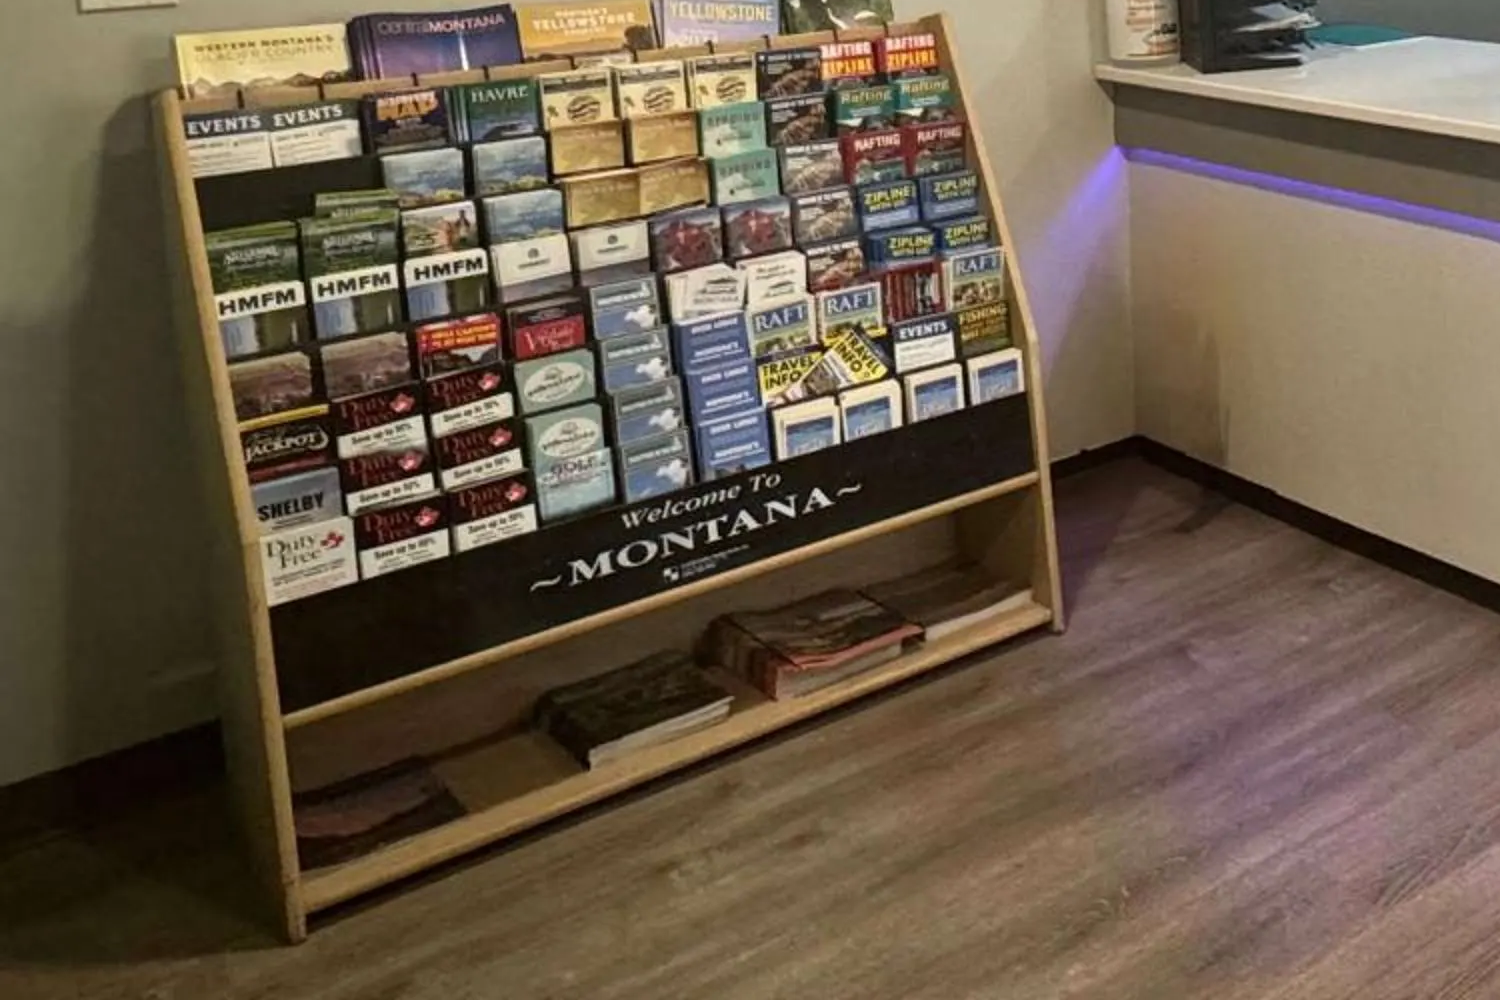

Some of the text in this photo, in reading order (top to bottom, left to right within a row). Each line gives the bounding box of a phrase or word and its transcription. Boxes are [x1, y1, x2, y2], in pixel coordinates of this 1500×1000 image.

[532, 11, 636, 32] YELLOWSTONE
[669, 1, 775, 22] YELLOWSTONE
[471, 85, 529, 103] HAVRE
[187, 115, 261, 135] EVENTS
[273, 104, 343, 127] EVENTS
[854, 133, 901, 152] RAFTING
[917, 125, 963, 144] RAFTING
[933, 175, 977, 194] ZIPLINE
[889, 234, 934, 249] ZIPLINE
[945, 222, 988, 240] ZIPLINE
[414, 257, 483, 280] HMFM
[956, 255, 997, 274] RAFT
[317, 271, 391, 297] HMFM
[219, 288, 296, 316] HMFM
[827, 290, 873, 315] RAFT
[755, 305, 804, 333] RAFT
[900, 320, 948, 339] EVENTS
[762, 355, 814, 377] TRAVEL
[838, 341, 862, 373] INFO
[850, 336, 880, 374] TRAVEL
[765, 370, 802, 391] INFO
[245, 434, 317, 463] JACKPOT
[257, 491, 324, 522] SHELBY
[621, 472, 782, 530] Welcome To
[267, 533, 316, 558] Duty
[568, 486, 836, 588] MONTANA
[280, 549, 322, 569] Free
